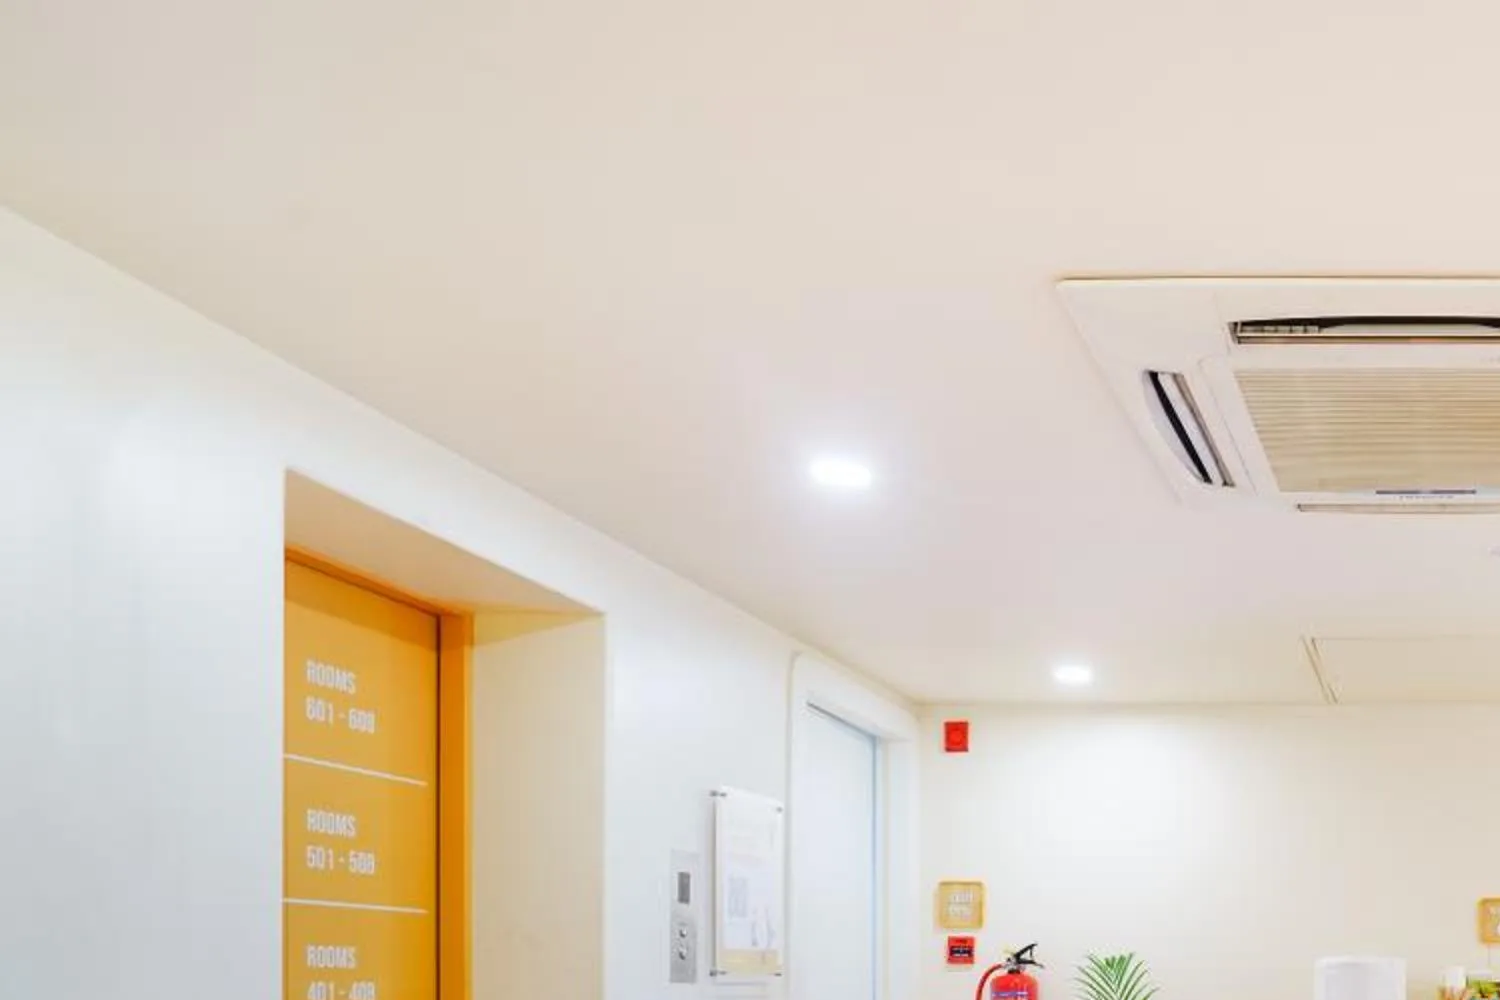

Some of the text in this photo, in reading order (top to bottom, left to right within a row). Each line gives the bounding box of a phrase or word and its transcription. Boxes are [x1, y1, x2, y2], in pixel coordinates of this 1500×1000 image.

[305, 659, 357, 695] ROOMS
[305, 696, 334, 725] 601
[306, 809, 357, 838] ROOMS
[306, 845, 334, 870] 501
[306, 944, 358, 969] ROOMS
